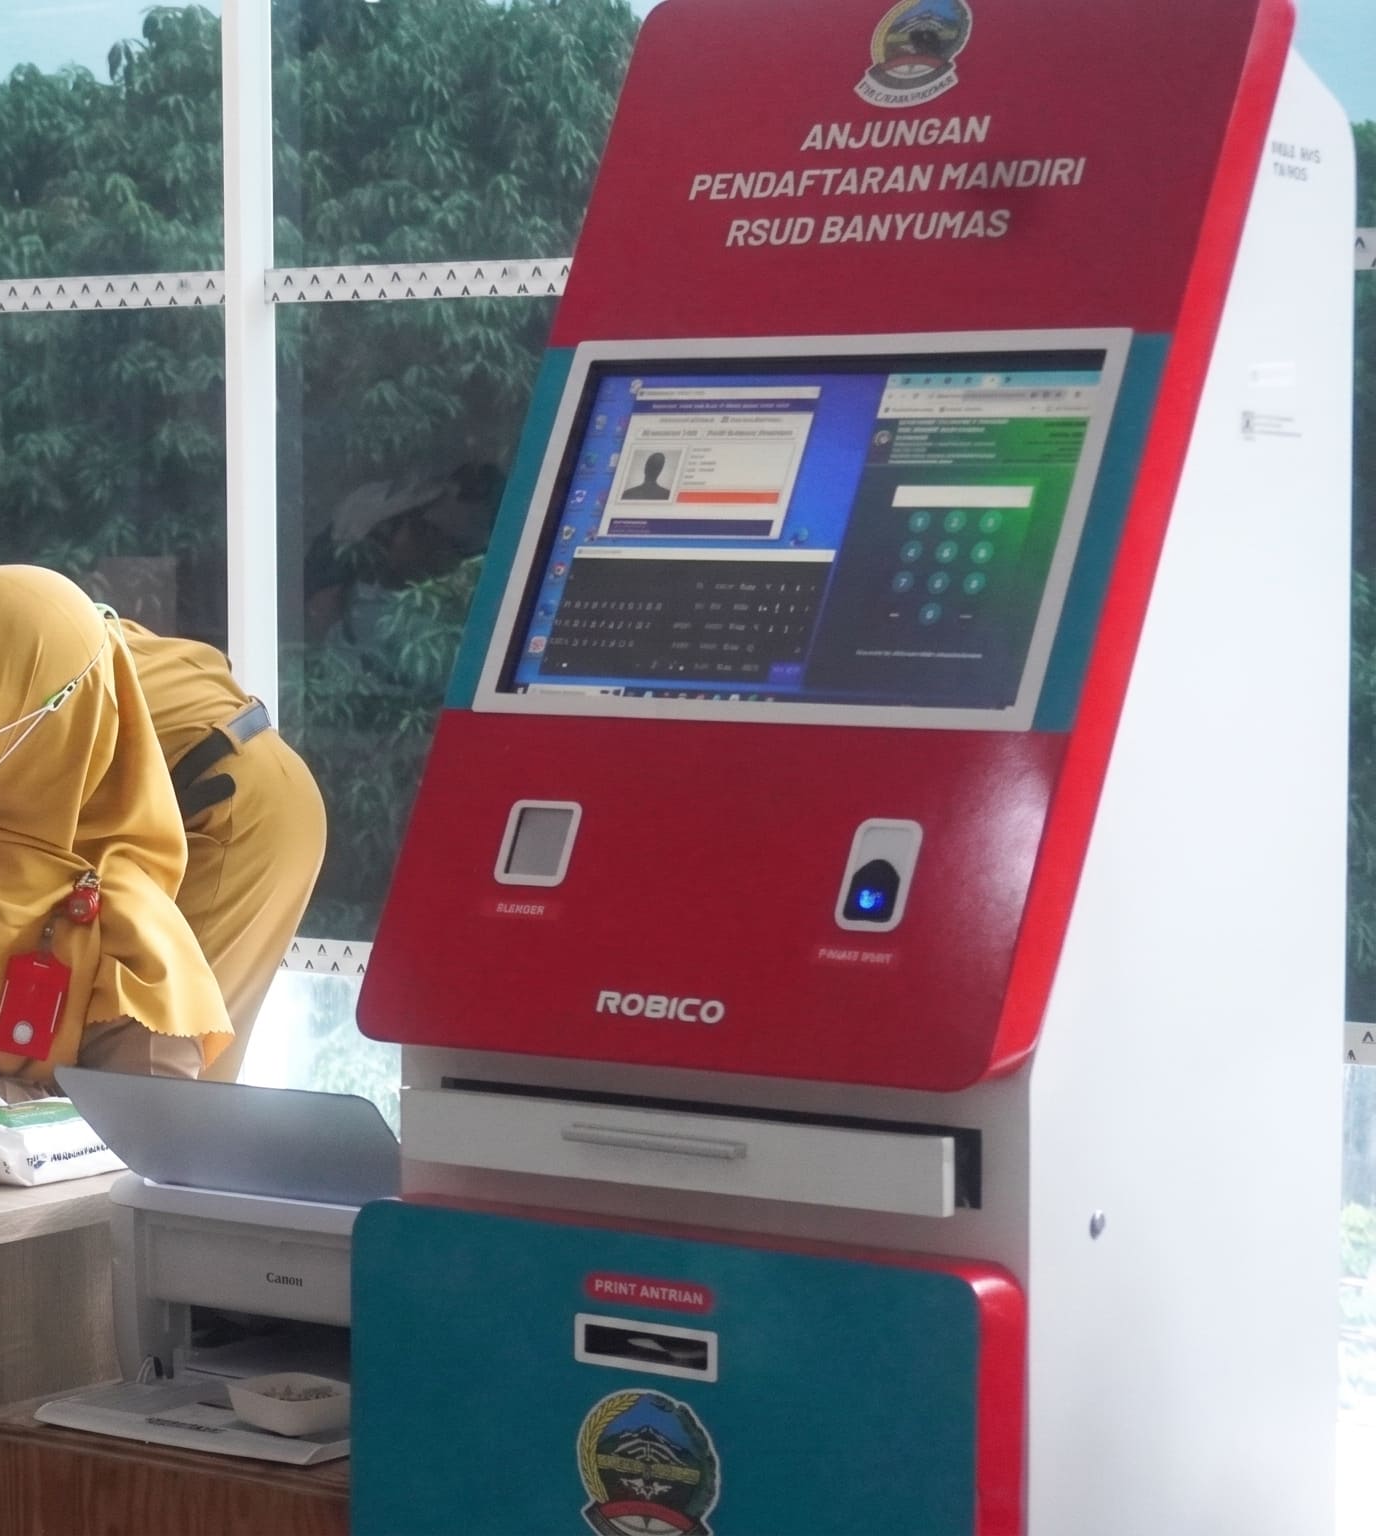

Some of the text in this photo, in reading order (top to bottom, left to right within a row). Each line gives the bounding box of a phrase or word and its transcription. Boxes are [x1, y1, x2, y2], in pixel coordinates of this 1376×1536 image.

[800, 115, 991, 152] ANJUNGAN
[688, 156, 1087, 201] PENDAFTARAN MANDIRI
[725, 208, 1011, 247] RSUD BANYUMAS
[596, 990, 725, 1024] ROBICO
[266, 1272, 303, 1287] Canon
[594, 1279, 704, 1305] PRINT ANTRIAN
